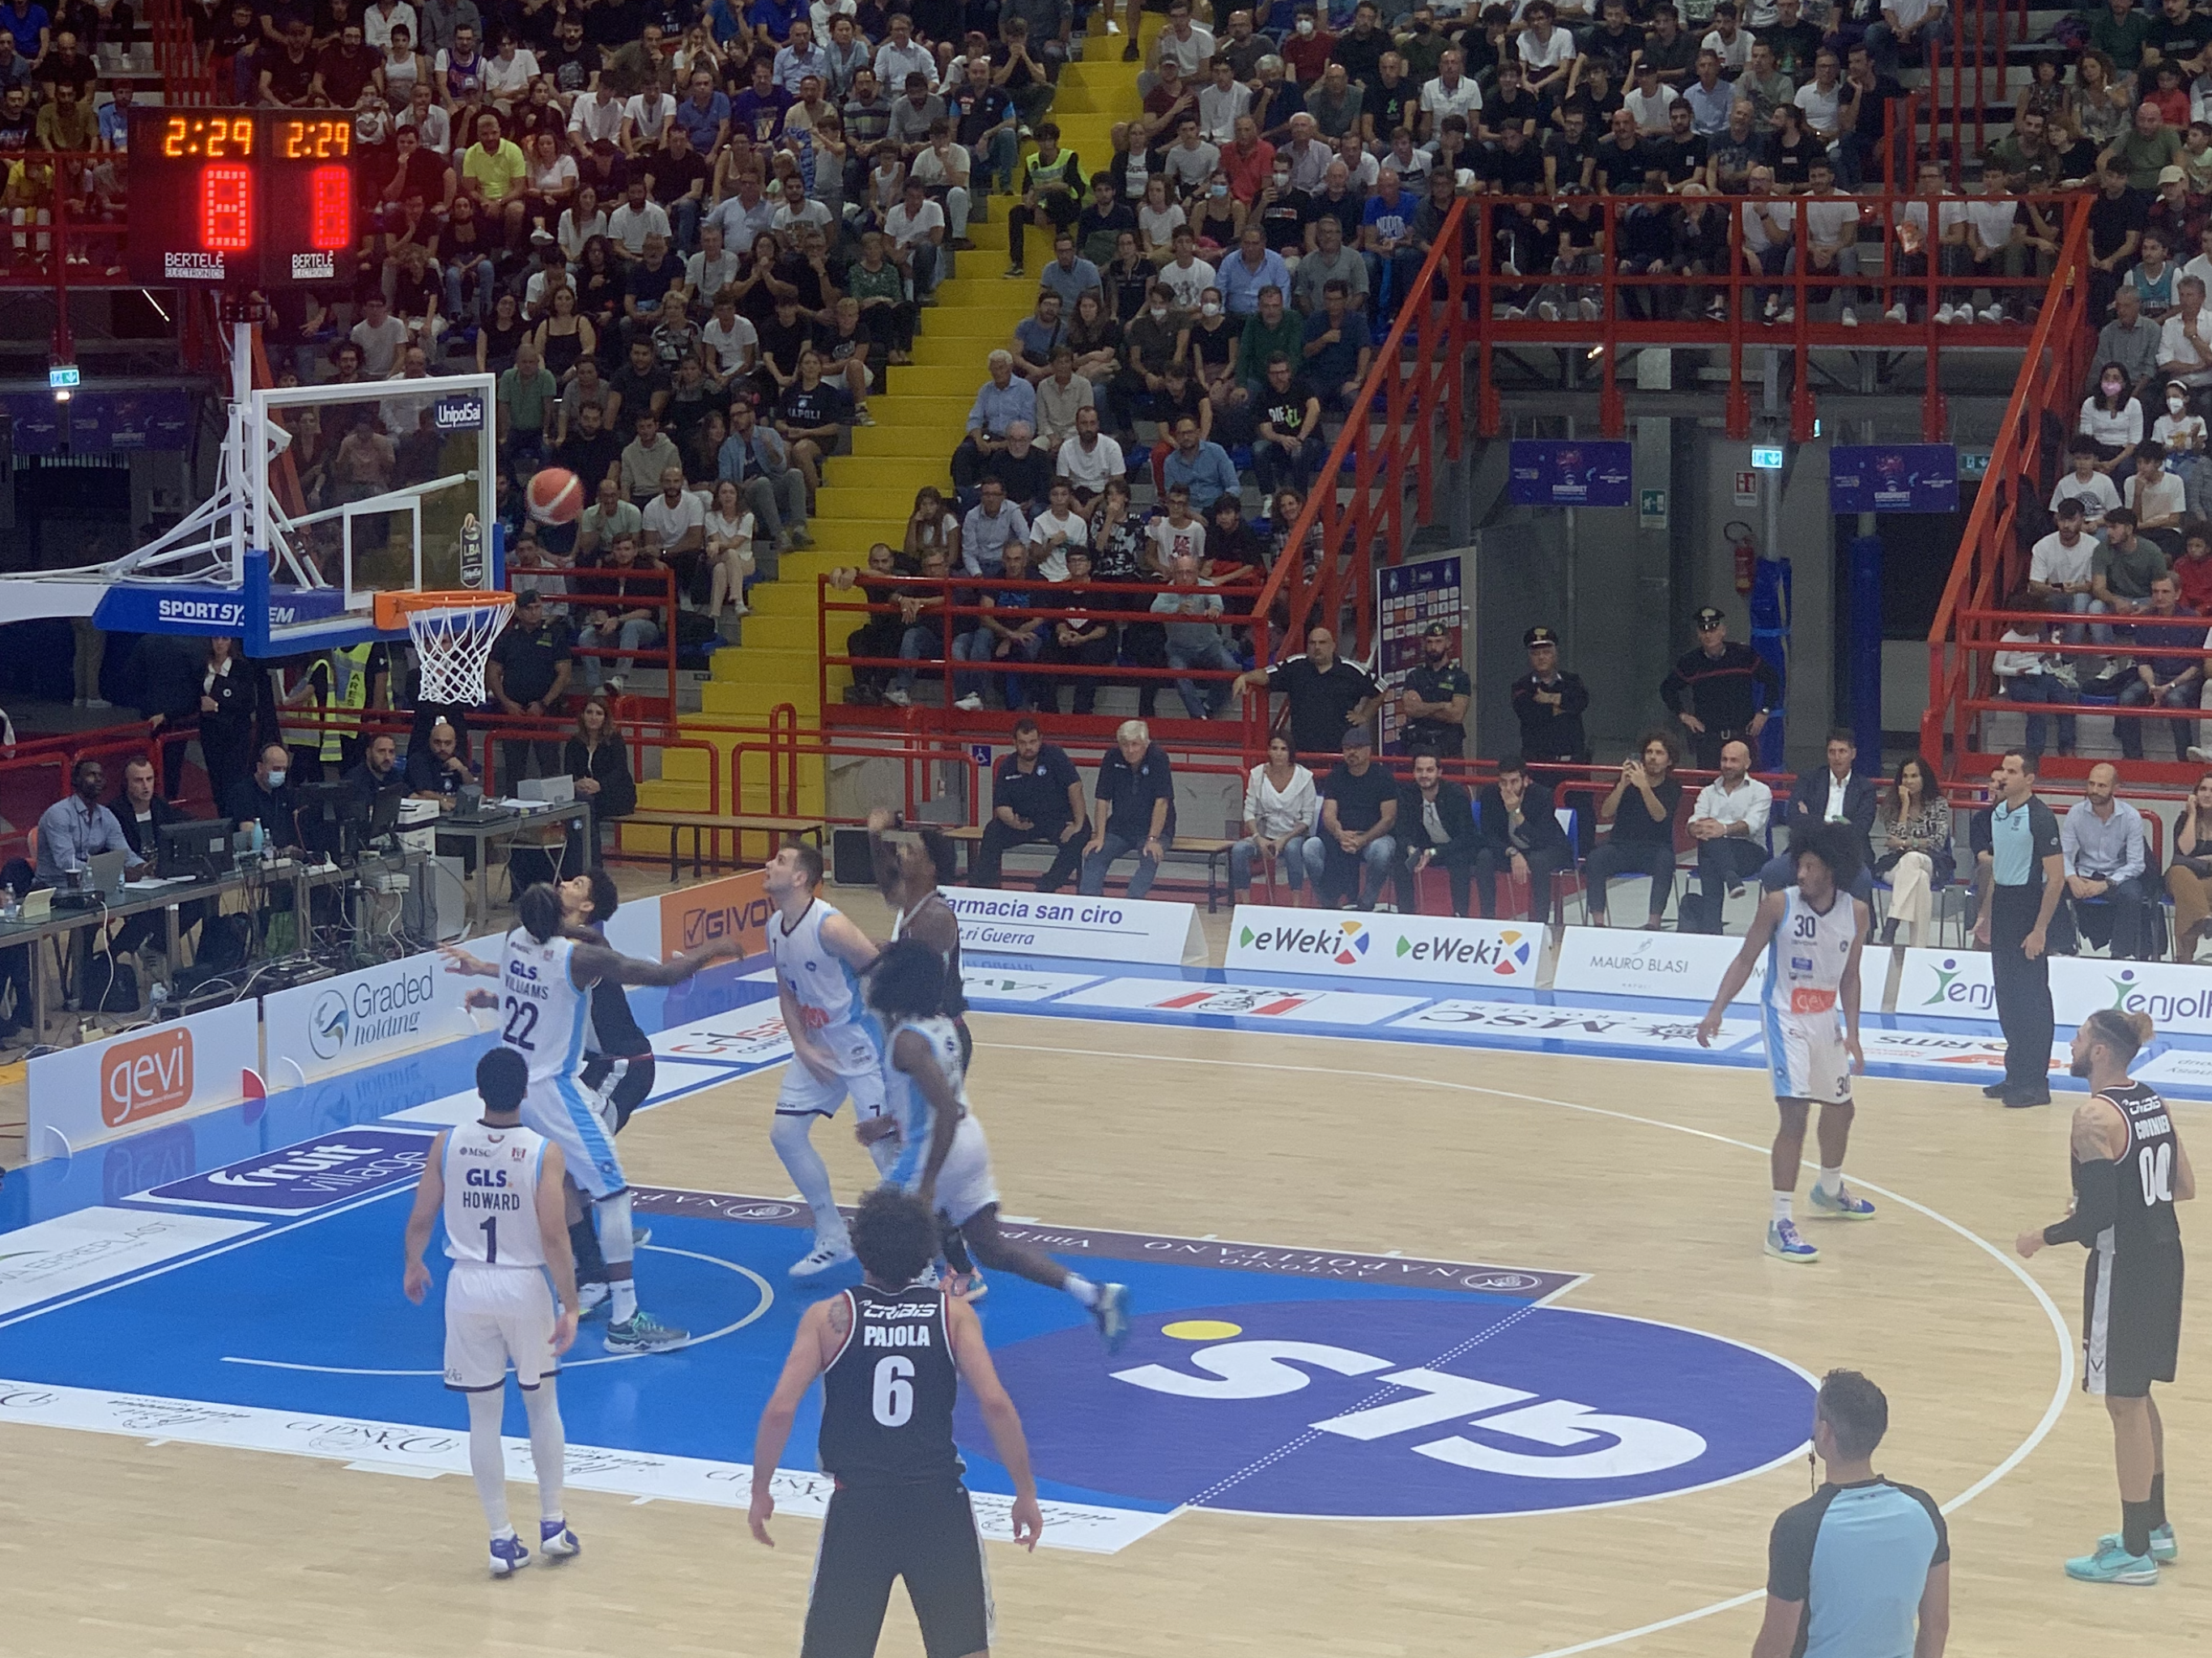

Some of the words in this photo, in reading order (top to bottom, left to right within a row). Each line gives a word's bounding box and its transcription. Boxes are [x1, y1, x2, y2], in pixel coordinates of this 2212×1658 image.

[165, 119, 253, 155] 2:29
[287, 122, 350, 157] 2:29
[438, 402, 480, 427] UnipolSai
[464, 543, 480, 556] LBA
[347, 674, 360, 707] ARES
[946, 899, 1029, 919] armacia
[1036, 903, 1074, 921] san
[1081, 905, 1123, 925] ciro
[981, 927, 1035, 946] Guerra
[1794, 915, 1816, 937] 30
[1590, 956, 1644, 970] MAURO
[1648, 959, 1688, 973] BLASI
[354, 965, 433, 1018] Graded
[355, 1012, 420, 1047] holding
[503, 996, 538, 1051] 22
[1419, 1010, 1619, 1034] MSC
[110, 1031, 183, 1124] gevi
[1836, 1074, 1851, 1096] 30
[469, 1147, 491, 1157] MSC
[291, 1152, 428, 1191] village
[463, 1192, 520, 1210] HOWARD
[480, 1216, 496, 1264] 1
[1028, 1234, 1090, 1248] Vini
[1144, 1241, 1461, 1277] NAPOLITANO
[1219, 1258, 1374, 1276] ANTONIO
[864, 1325, 930, 1347] PAJOLA
[873, 1355, 915, 1427] 6
